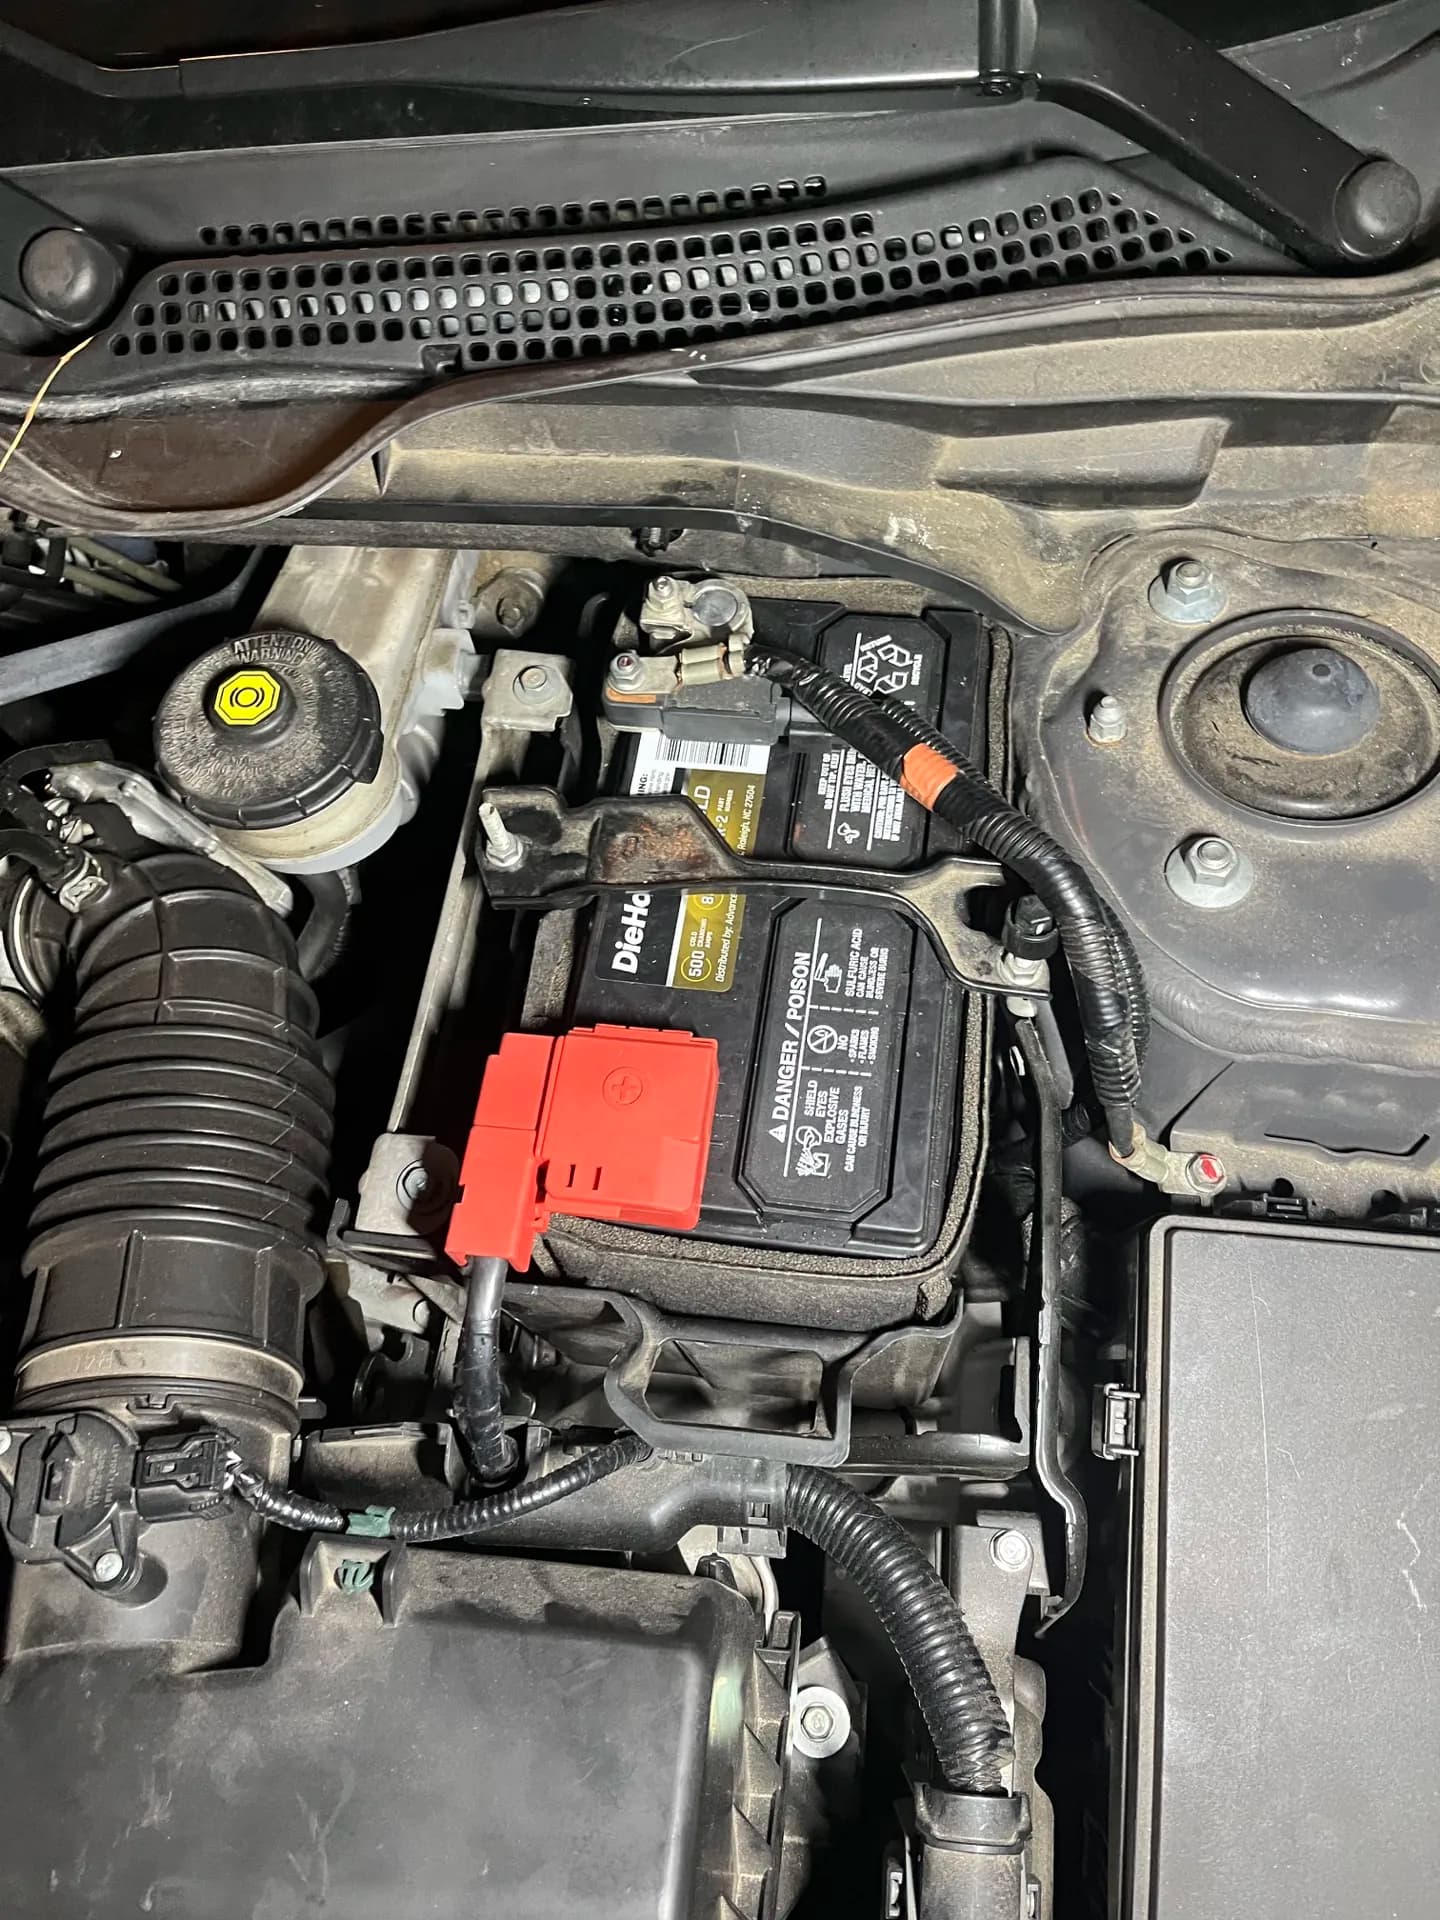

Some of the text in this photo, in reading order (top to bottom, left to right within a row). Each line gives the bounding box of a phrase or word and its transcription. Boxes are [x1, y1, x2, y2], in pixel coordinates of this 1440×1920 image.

[637, 772, 649, 796] ING:
[843, 765, 856, 786] EYES
[693, 785, 711, 815] LD
[742, 807, 752, 821] NC
[839, 786, 852, 812] FLUSH
[850, 791, 863, 813] WITH
[861, 779, 875, 814] MEDICAL
[688, 950, 705, 977] 500
[715, 939, 732, 983] Distributed
[845, 928, 863, 997] SULFURIC ACID
[856, 956, 869, 998] CAN CAUSE
[875, 947, 889, 1000] SEVERE BURNS
[771, 1039, 799, 1121] DANGER
[786, 951, 811, 1021] POISON
[837, 1034, 849, 1050] NO
[804, 1079, 818, 1117] SHIELD
[815, 1090, 828, 1118] EYES
[823, 1086, 840, 1144] EXPLOSIVE
[835, 1109, 849, 1144] GASES
[844, 1085, 863, 1172] CAN CAUSE BLINDNESS
[858, 1106, 871, 1147] OR INJURY
